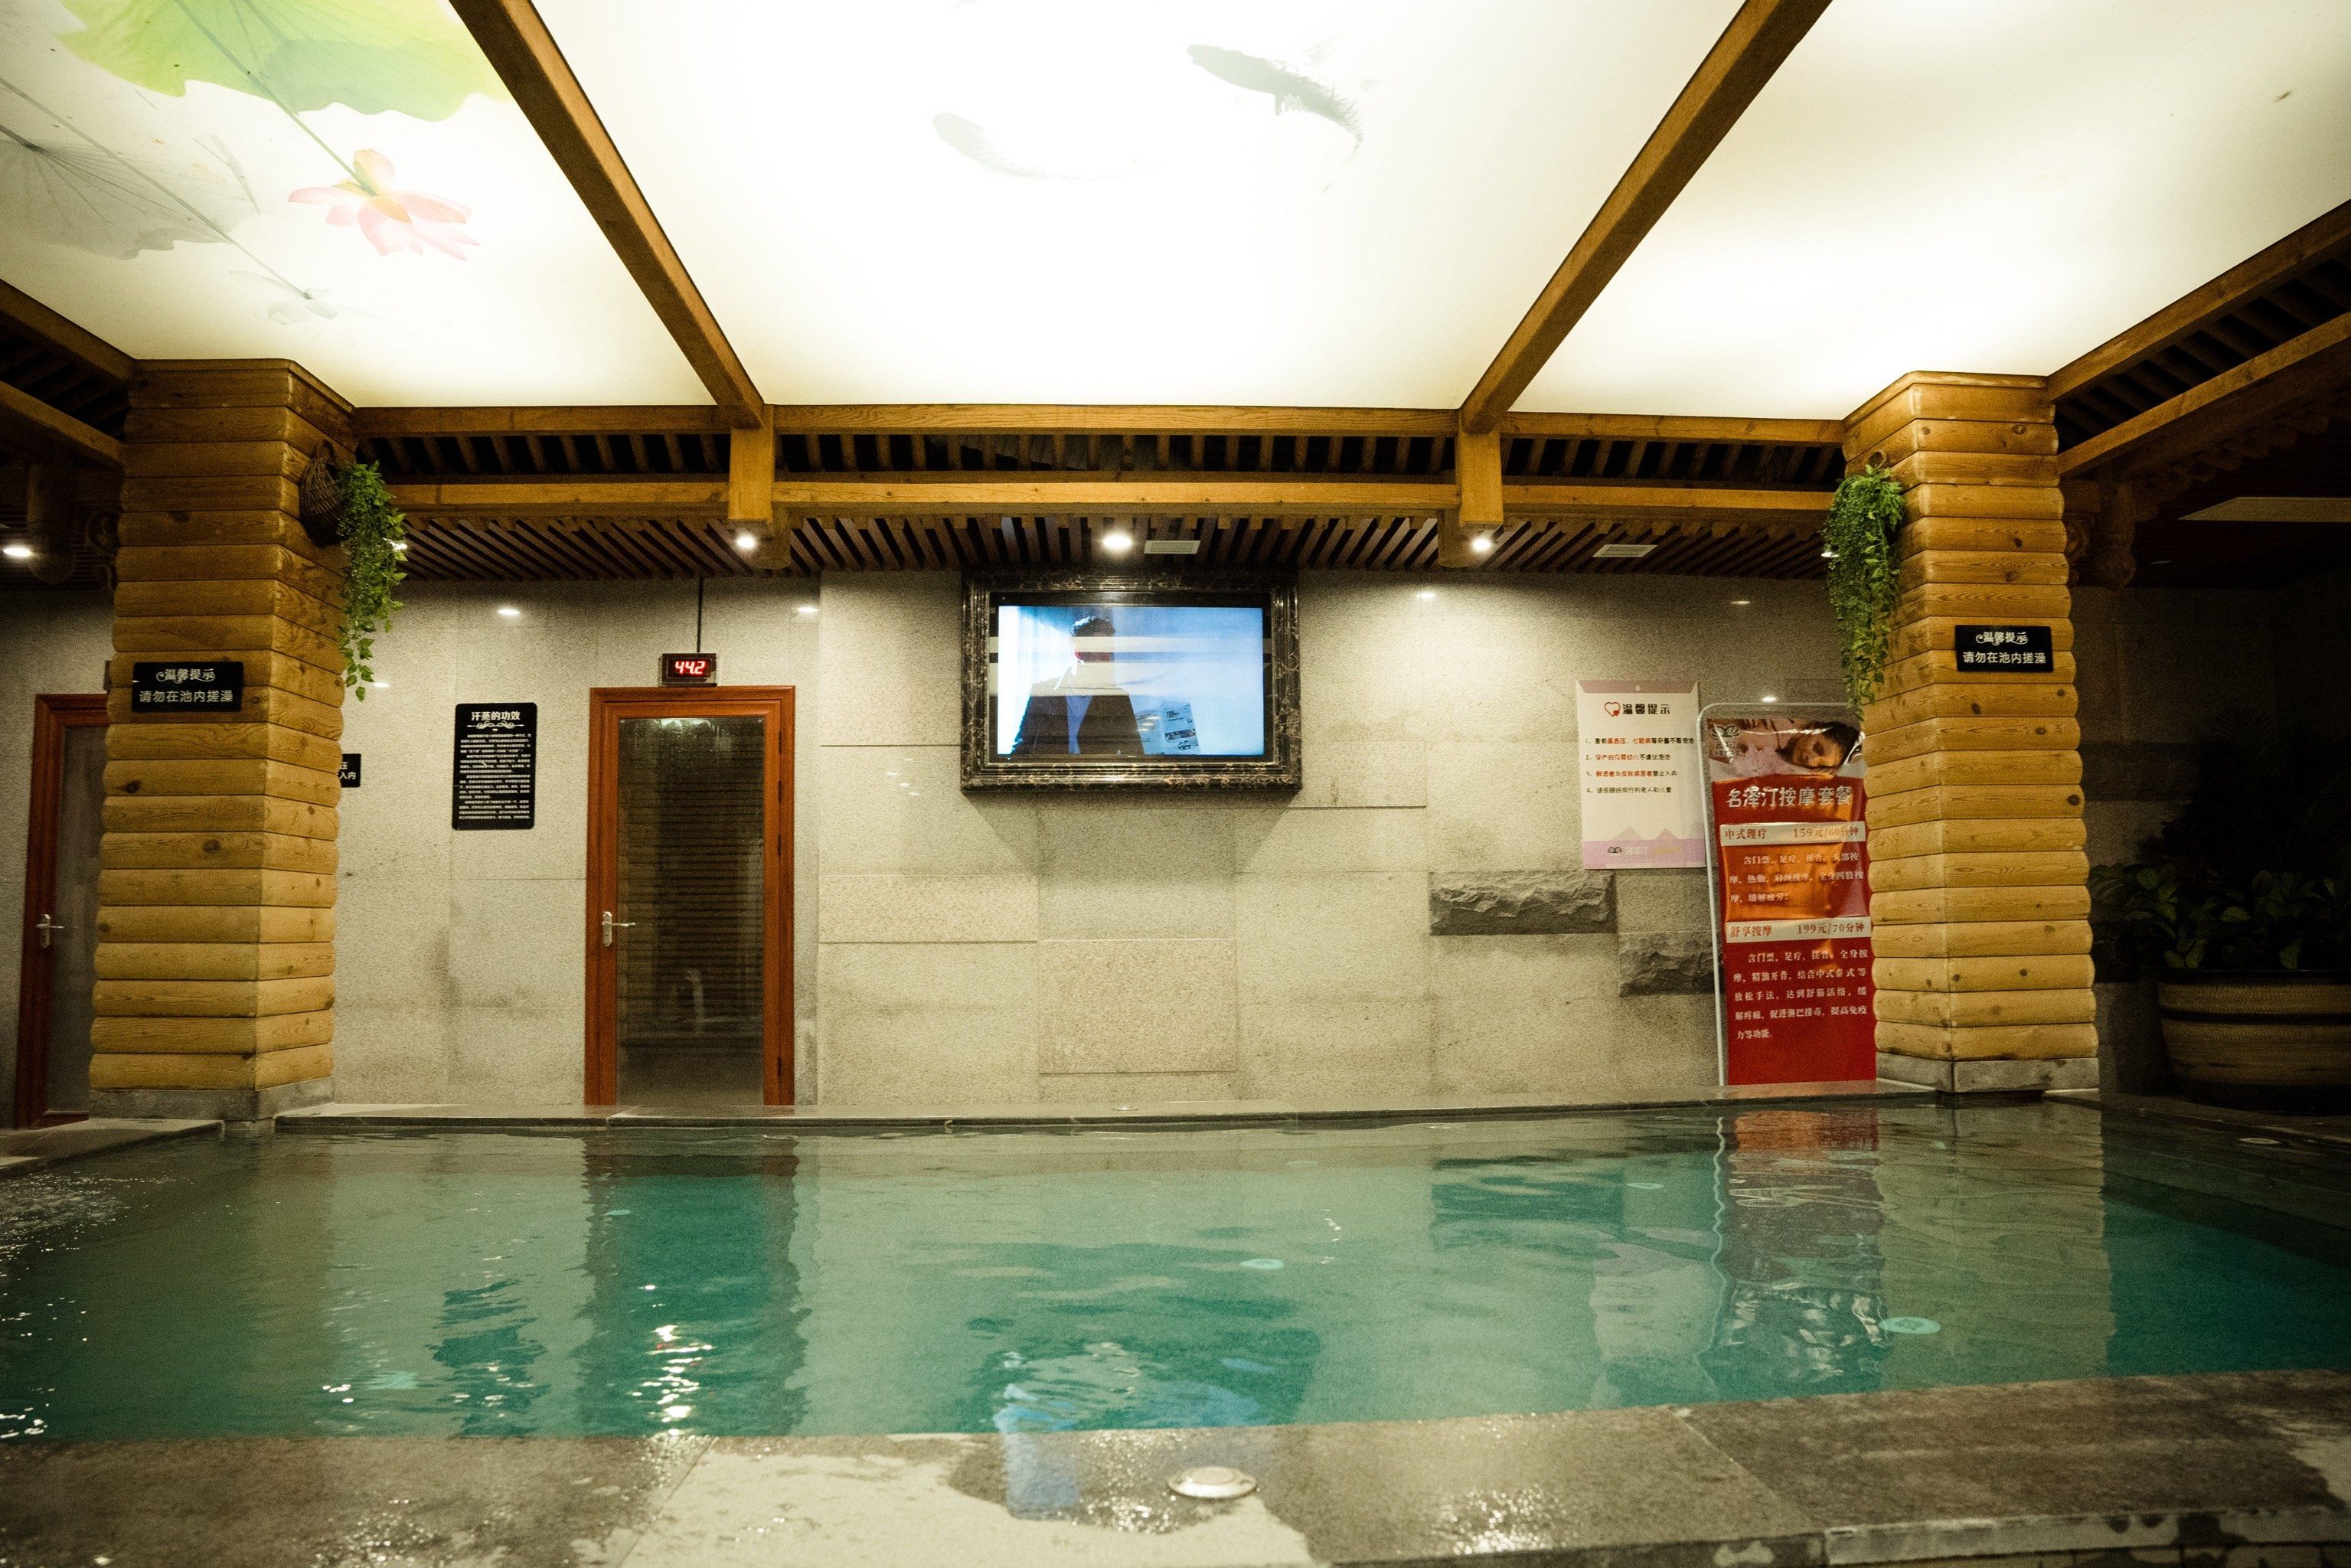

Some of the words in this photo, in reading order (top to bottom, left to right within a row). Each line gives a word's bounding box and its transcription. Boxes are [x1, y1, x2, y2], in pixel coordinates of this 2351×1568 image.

[1976, 632, 2029, 646] 温馨提示
[1963, 652, 2046, 664] 请勿在池内搓澡
[155, 668, 216, 684] 温馨提示
[139, 690, 233, 703] 请勿在池内搓澡
[471, 710, 521, 721] 汗蒸的功效
[1622, 704, 1670, 715] 温馨提示
[1726, 786, 1853, 808] 名泽汀按摩套餐
[1725, 828, 1768, 840] 中式理疗
[1730, 925, 1773, 937] 舒享按摩
[1798, 923, 1865, 935] 199元/70分钟
